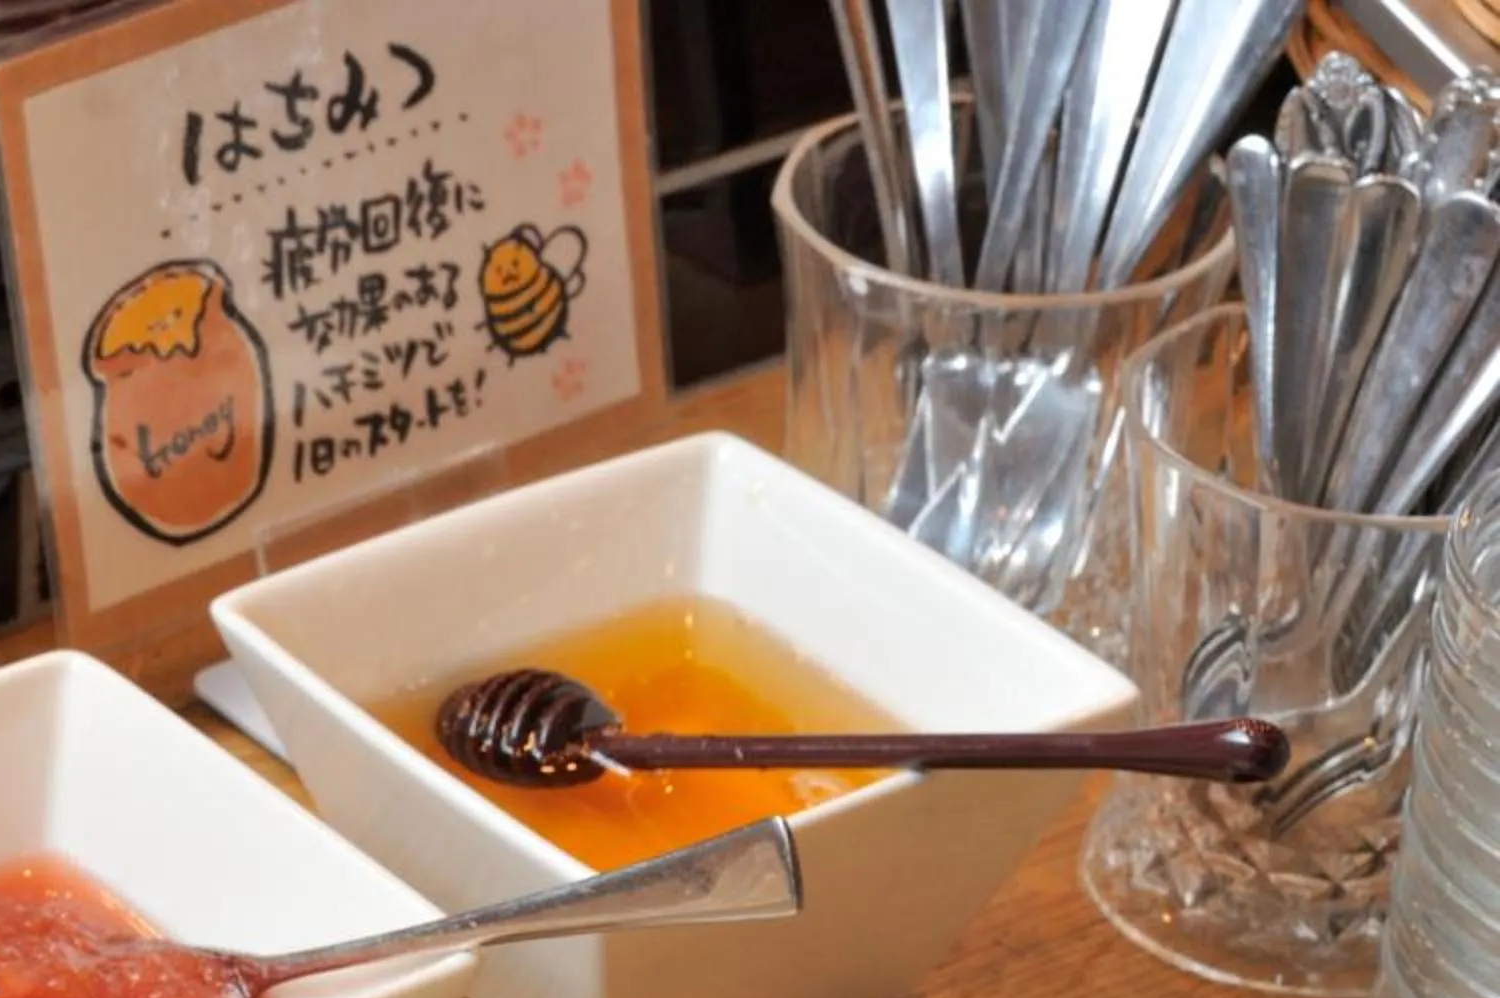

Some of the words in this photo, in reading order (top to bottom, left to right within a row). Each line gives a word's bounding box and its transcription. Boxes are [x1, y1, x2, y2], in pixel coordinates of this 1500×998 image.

[181, 42, 438, 187] はちみつ
[287, 263, 461, 354] 効果のある
[293, 323, 454, 428] ハチミツで
